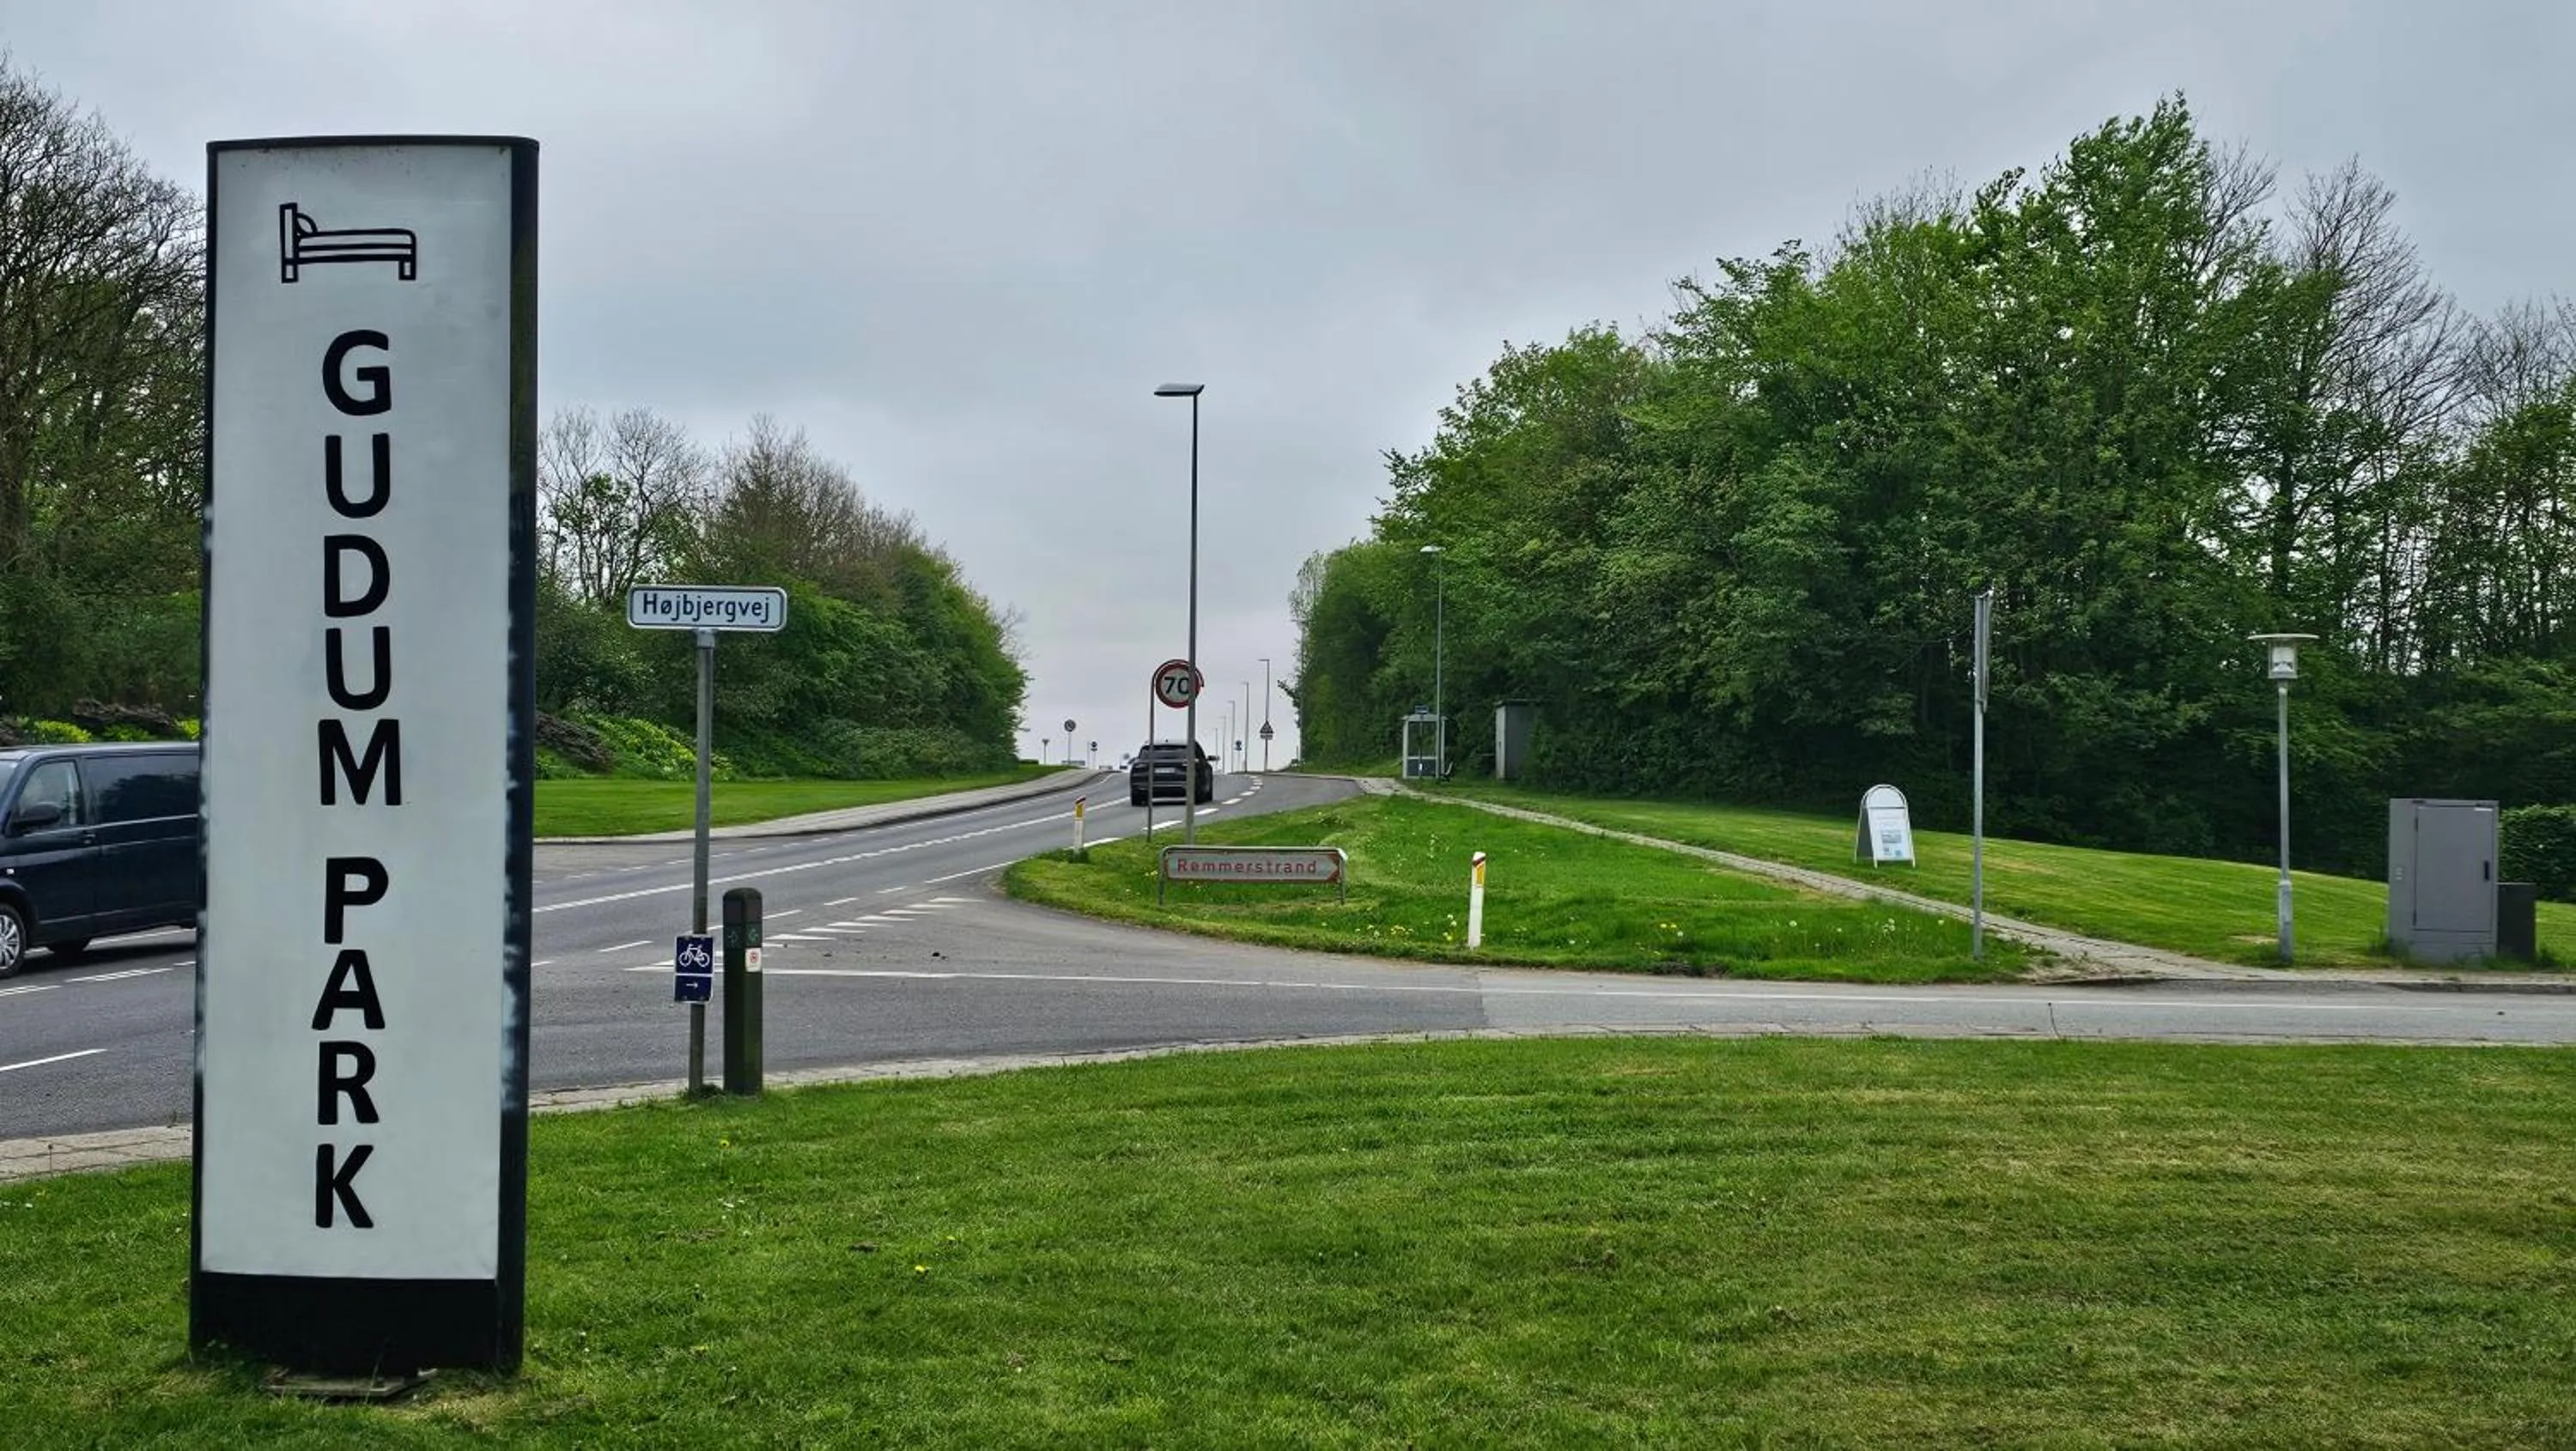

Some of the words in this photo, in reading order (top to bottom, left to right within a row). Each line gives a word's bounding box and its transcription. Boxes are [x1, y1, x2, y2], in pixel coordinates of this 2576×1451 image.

[319, 329, 401, 805] GUDUM
[643, 592, 769, 623] Højbjergvej
[1177, 859, 1317, 874] Remmerstrand
[312, 856, 388, 1229] PARK
